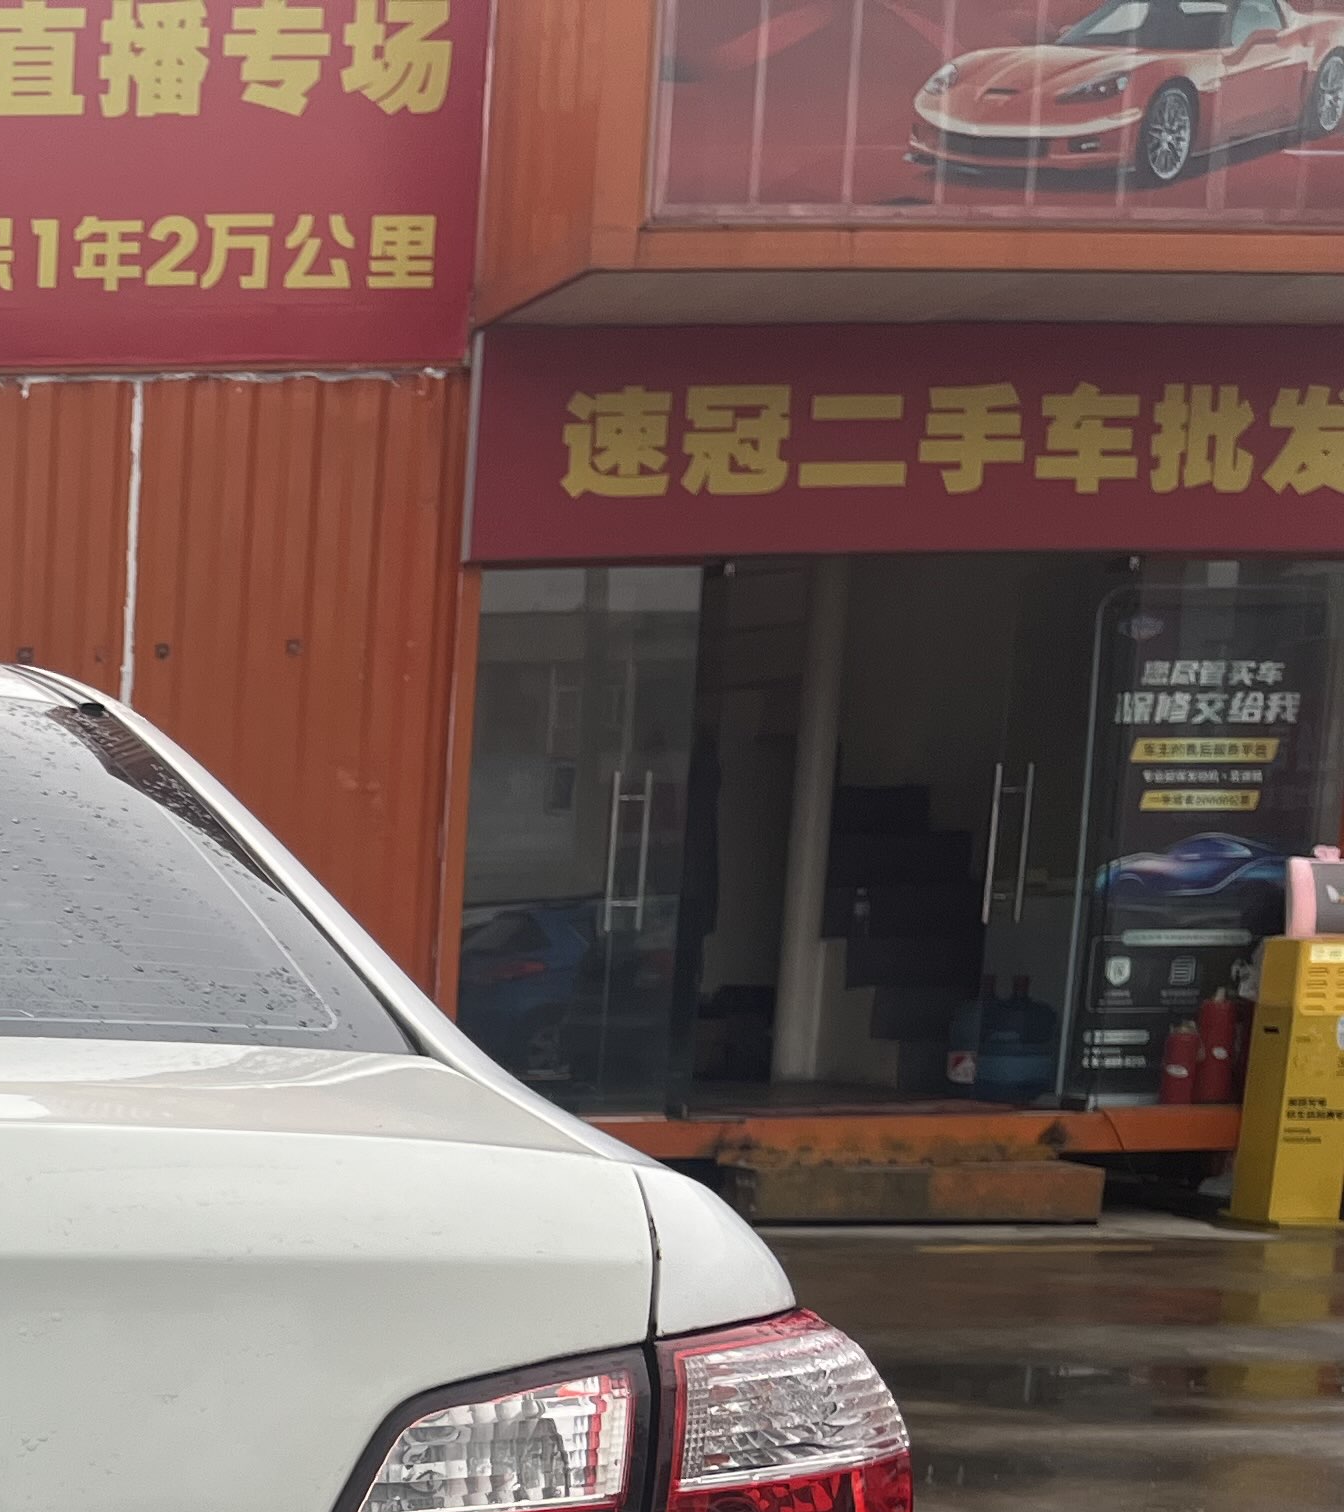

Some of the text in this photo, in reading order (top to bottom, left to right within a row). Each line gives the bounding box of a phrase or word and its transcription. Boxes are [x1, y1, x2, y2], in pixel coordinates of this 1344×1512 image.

[560, 382, 1344, 500] 速冠二手车批发
[1115, 691, 1301, 725] 保修交给我
